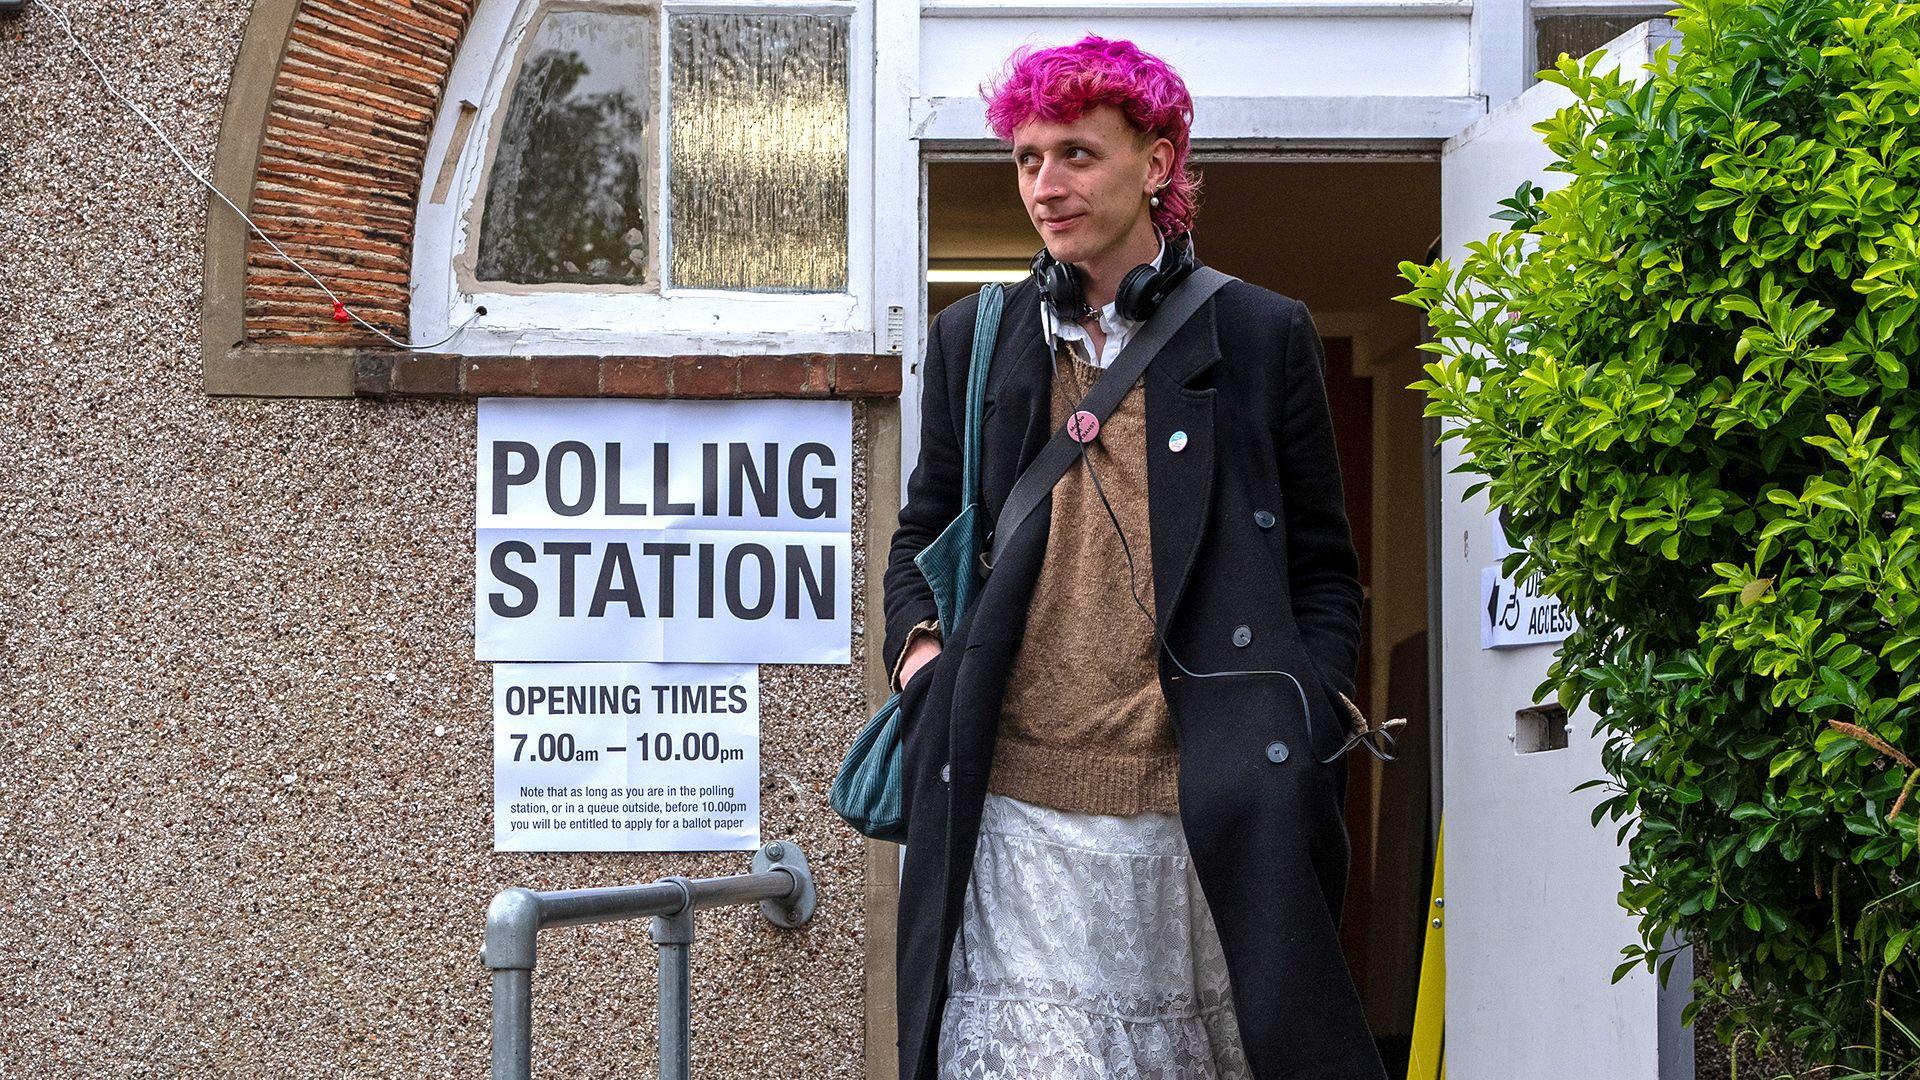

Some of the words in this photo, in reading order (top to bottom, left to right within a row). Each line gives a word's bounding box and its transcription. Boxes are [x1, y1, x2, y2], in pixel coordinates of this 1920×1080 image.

[492, 440, 837, 519] POLLING
[488, 541, 835, 620] STATION
[1528, 604, 1573, 635] ACCESS
[505, 685, 641, 716] OPENING
[651, 684, 748, 714] TIMES
[510, 733, 599, 762] 7.00am
[636, 732, 744, 764] 10.00pm
[520, 786, 545, 798] Note
[546, 786, 568, 798] that
[570, 788, 583, 798] as
[585, 786, 608, 800] long
[610, 787, 623, 797] as
[625, 787, 645, 800] you
[647, 787, 665, 797] are
[667, 785, 677, 797] in
[679, 785, 697, 797] the
[699, 784, 735, 799] polling
[510, 802, 549, 815] station,
[551, 804, 563, 814] or
[565, 802, 575, 814] in
[577, 804, 585, 814] a
[587, 803, 620, 816] queue
[622, 801, 663, 815] outside,
[665, 801, 699, 813] before
[701, 801, 747, 815] 10.00pm
[510, 820, 530, 832] you
[532, 818, 551, 830] will
[553, 818, 567, 830] be
[569, 817, 609, 830] entitled
[610, 818, 622, 830] to
[624, 817, 653, 832] apply
[655, 817, 671, 829] for
[672, 819, 680, 829] a
[682, 817, 712, 829] ballot
[714, 819, 745, 831] paper
